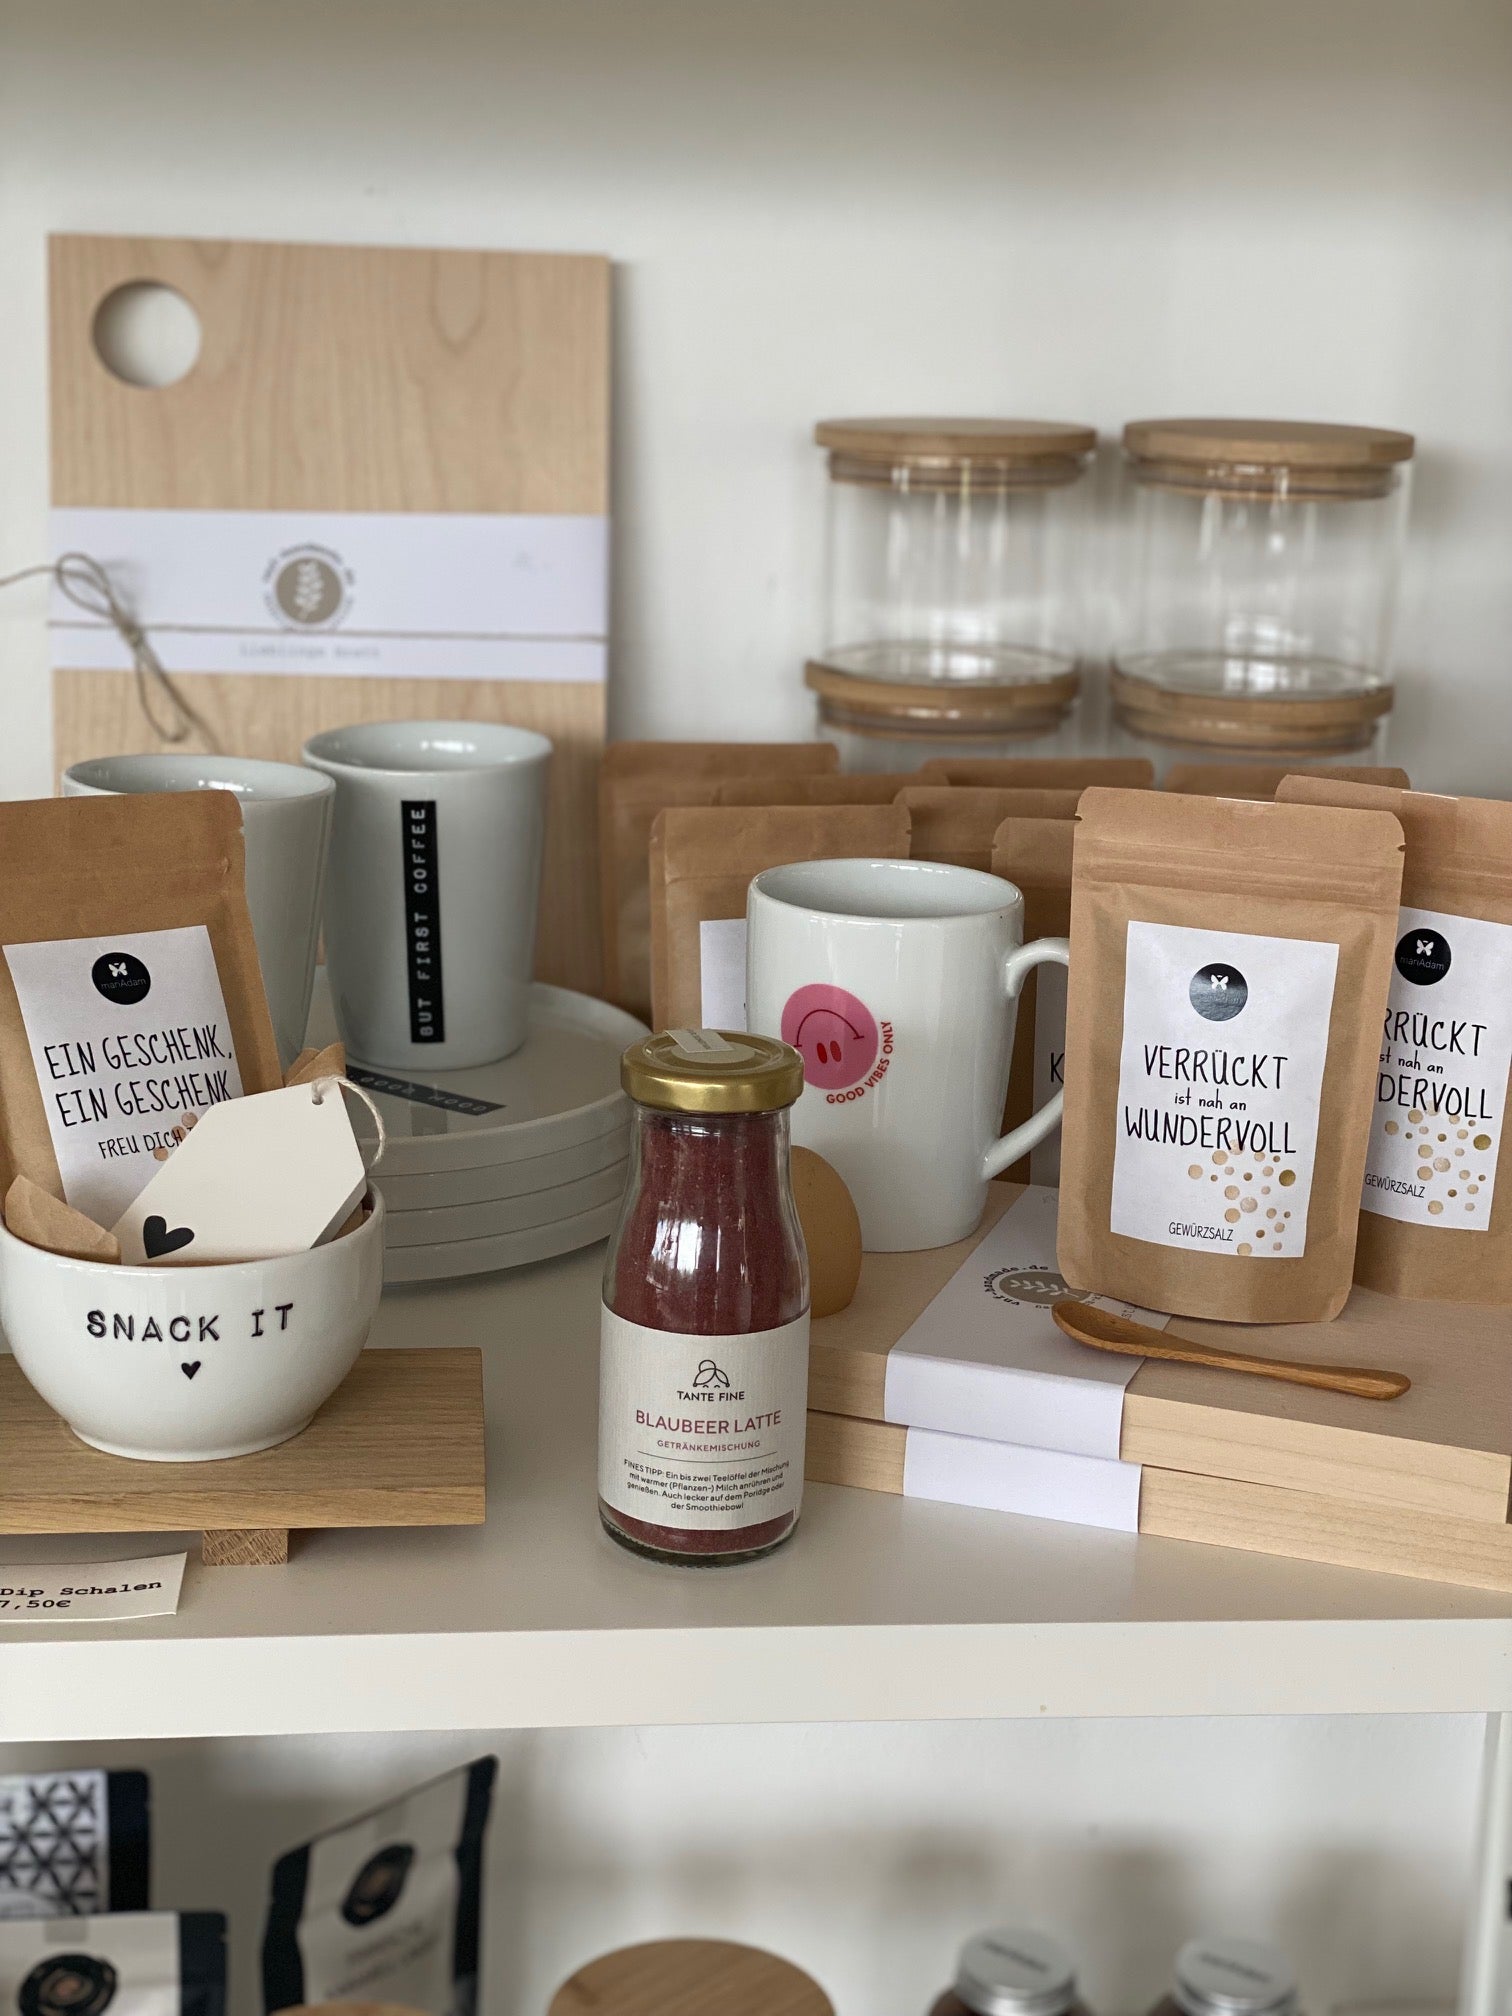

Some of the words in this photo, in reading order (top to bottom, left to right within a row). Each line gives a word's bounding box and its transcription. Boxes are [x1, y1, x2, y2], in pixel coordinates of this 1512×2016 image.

[411, 808, 429, 894] COFFEE
[414, 912, 431, 981] FIRST
[417, 998, 434, 1037] BUT
[43, 1041, 97, 1080] EIN
[102, 1024, 232, 1070] GESCHENK,
[826, 1086, 865, 1104] GOOD
[864, 1058, 890, 1089] VIBES
[880, 1020, 894, 1055] ONLY
[1398, 1050, 1421, 1071] nah
[1427, 1064, 1444, 1075] an
[1144, 1044, 1288, 1090] VERRÜCKT
[55, 1087, 109, 1128] EIN
[114, 1070, 232, 1116] GESCHENK
[1174, 1087, 1191, 1107] ist
[1199, 1088, 1223, 1111] nah
[1229, 1099, 1247, 1112] an
[1125, 1106, 1297, 1154] WUNDERVOLL
[98, 1135, 141, 1160] FREU
[143, 1130, 184, 1151] DICH
[1364, 1173, 1426, 1199] GEWÜRZSALZ
[1168, 1221, 1234, 1242] GEWÜRZSALZ
[87, 1309, 220, 1343] SNACK
[251, 1303, 294, 1338] IT
[676, 1390, 715, 1402] TANTE
[718, 1391, 746, 1402] FINE
[636, 1409, 730, 1434] BLAUBEER
[734, 1409, 782, 1433] LATTE
[657, 1439, 761, 1453] GETRÄNKEMISCHUNG
[623, 1458, 644, 1472] FINES
[665, 1471, 679, 1479] Ein
[680, 1473, 692, 1481] bis
[713, 1473, 748, 1482] Teelöffel
[748, 1470, 760, 1479] der
[761, 1460, 790, 1476] Mischung
[629, 1472, 640, 1481] mit
[641, 1476, 668, 1488] warmer
[669, 1481, 715, 1493] (Pflanzen-)
[716, 1483, 739, 1492] Milch
[739, 1477, 771, 1490] anrühren
[771, 1471, 784, 1482] und
[661, 1490, 683, 1500] Auch
[684, 1493, 709, 1502] lecker
[724, 1493, 743, 1502] dem
[771, 1481, 785, 1492] oder
[670, 1502, 684, 1510] der
[685, 1502, 744, 1512] Smoothiebowl
[0, 1587, 45, 1598] Dip
[60, 1580, 163, 1596] Schalen
[0, 1599, 72, 1610] 7,50€
